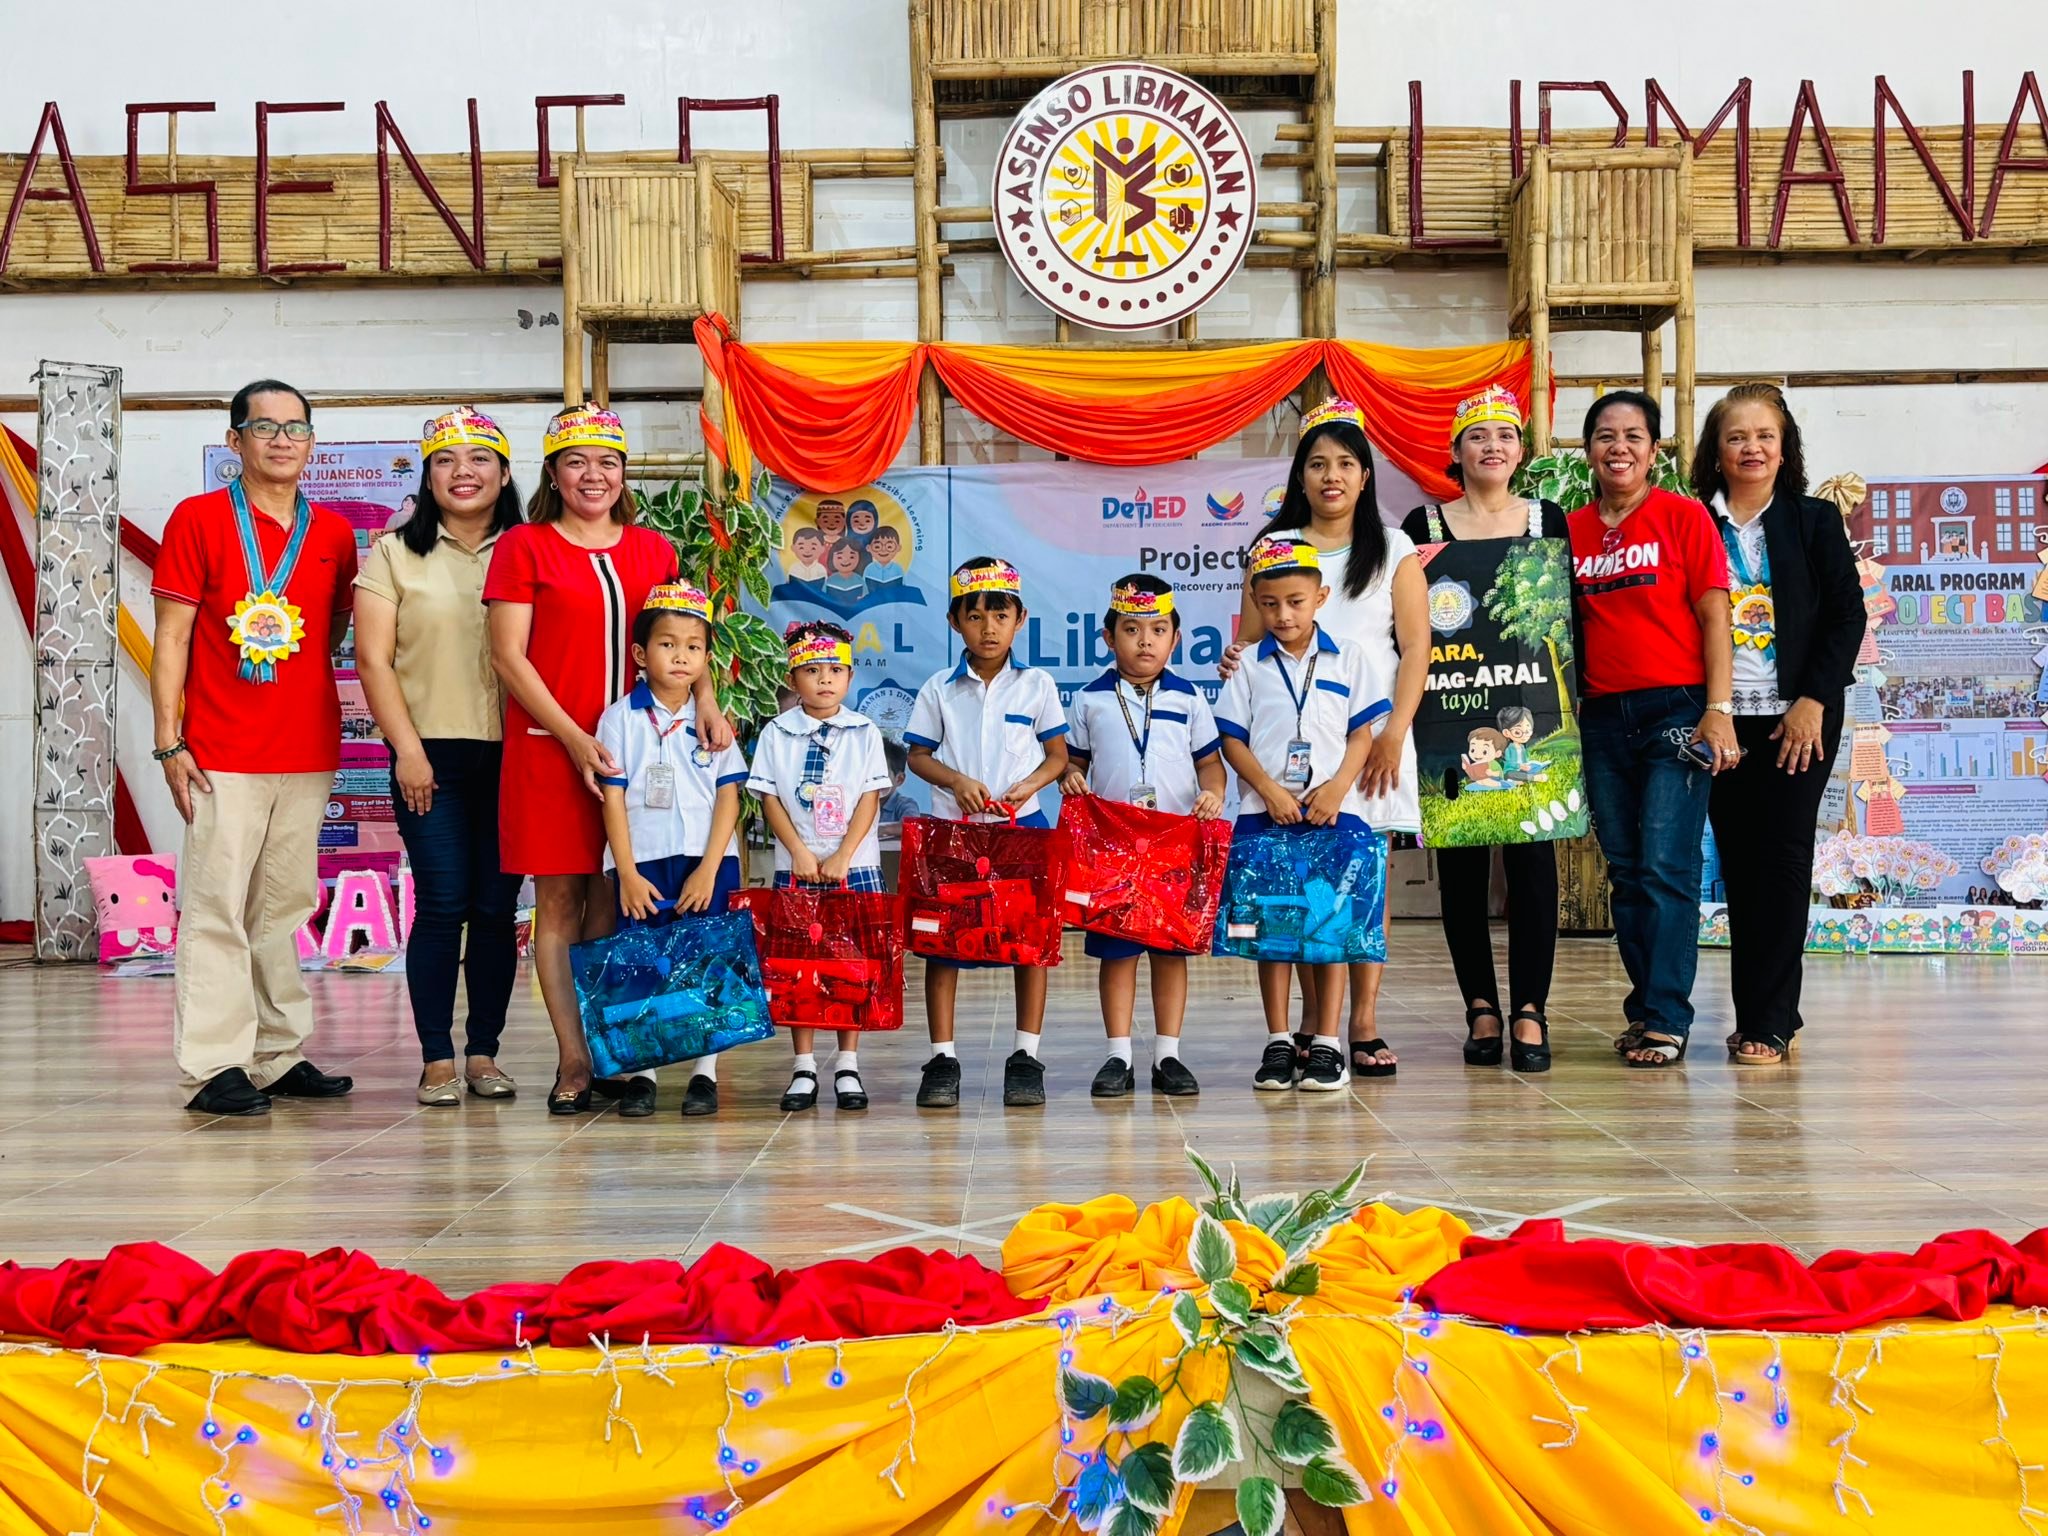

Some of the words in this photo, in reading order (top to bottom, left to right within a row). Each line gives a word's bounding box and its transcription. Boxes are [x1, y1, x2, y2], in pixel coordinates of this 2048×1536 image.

[1005, 84, 1093, 204] ASENSO
[1102, 75, 1246, 195] LIBMANAN
[1409, 70, 2048, 249] LIMANA
[307, 454, 344, 464] OJECT
[315, 467, 383, 480] JUANEÑOS
[1102, 496, 1187, 527] DepED
[906, 504, 925, 552] Learning
[1140, 545, 1249, 577] Project
[1173, 582, 1223, 594] Recovery
[1890, 573, 1935, 592] ARAL
[1940, 572, 2025, 591] PROGRAM
[1881, 593, 1977, 625] ROJECT
[1985, 593, 2048, 624] BAS
[1431, 643, 1484, 663] ARA,
[861, 690, 886, 712] MANAN
[1440, 688, 1490, 715] tayo!
